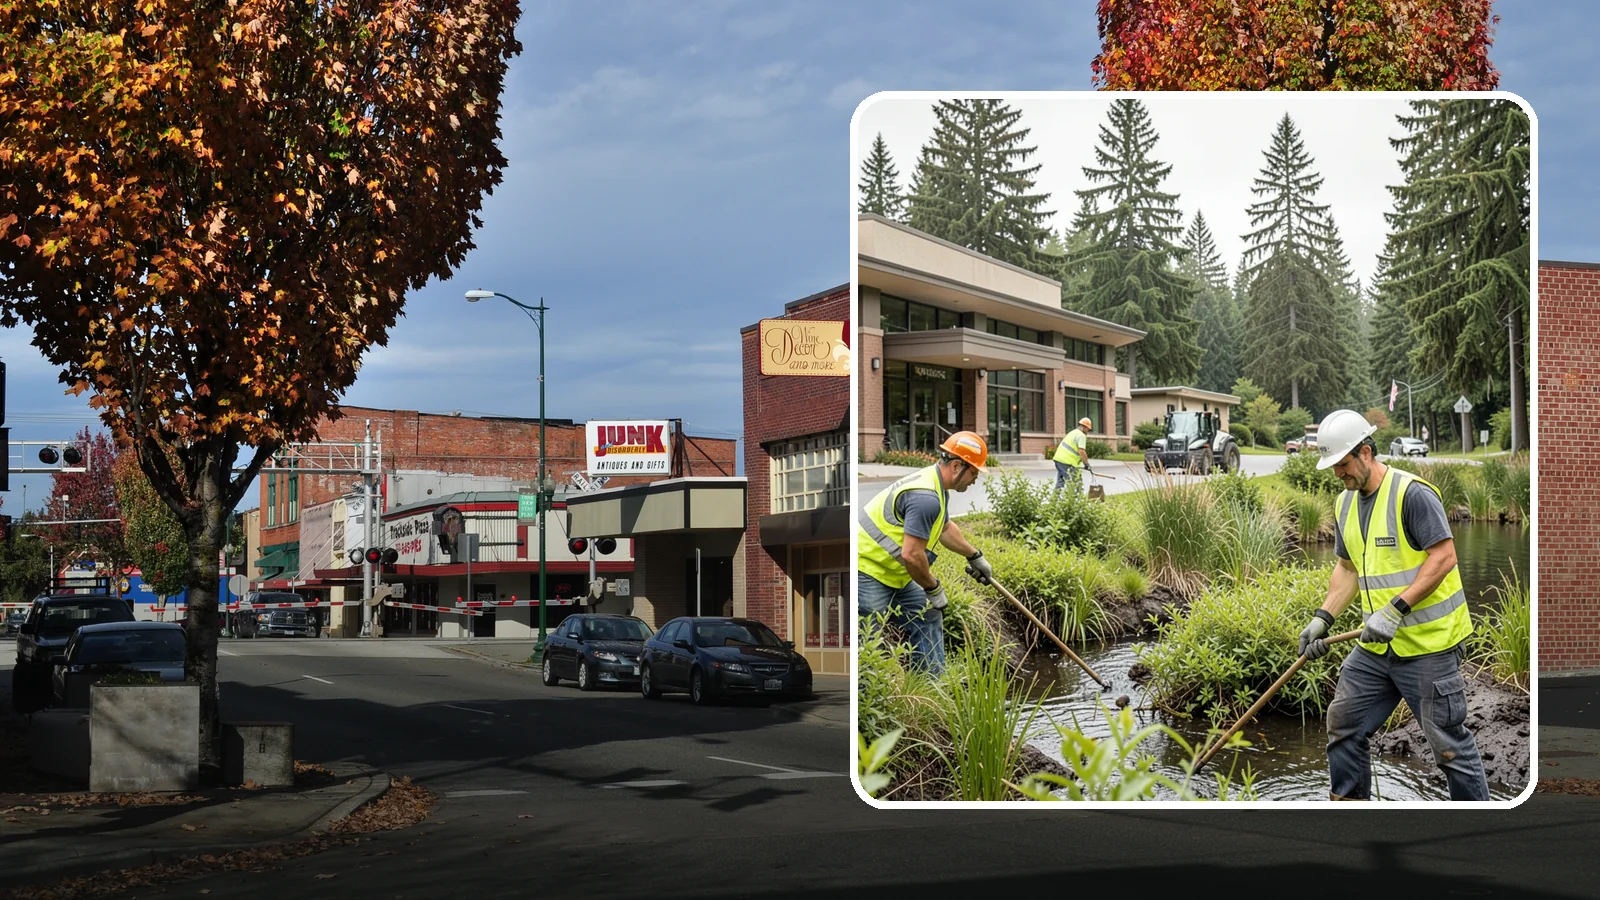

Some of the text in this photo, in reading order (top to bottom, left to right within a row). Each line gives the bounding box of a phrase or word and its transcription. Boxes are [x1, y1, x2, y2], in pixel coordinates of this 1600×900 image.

[596, 425, 665, 457] JUNK
[607, 446, 645, 454] DISORDERLY
[597, 460, 665, 470] ANTIQUES AND GIFTS
[390, 519, 429, 540] Trackside Pizza
